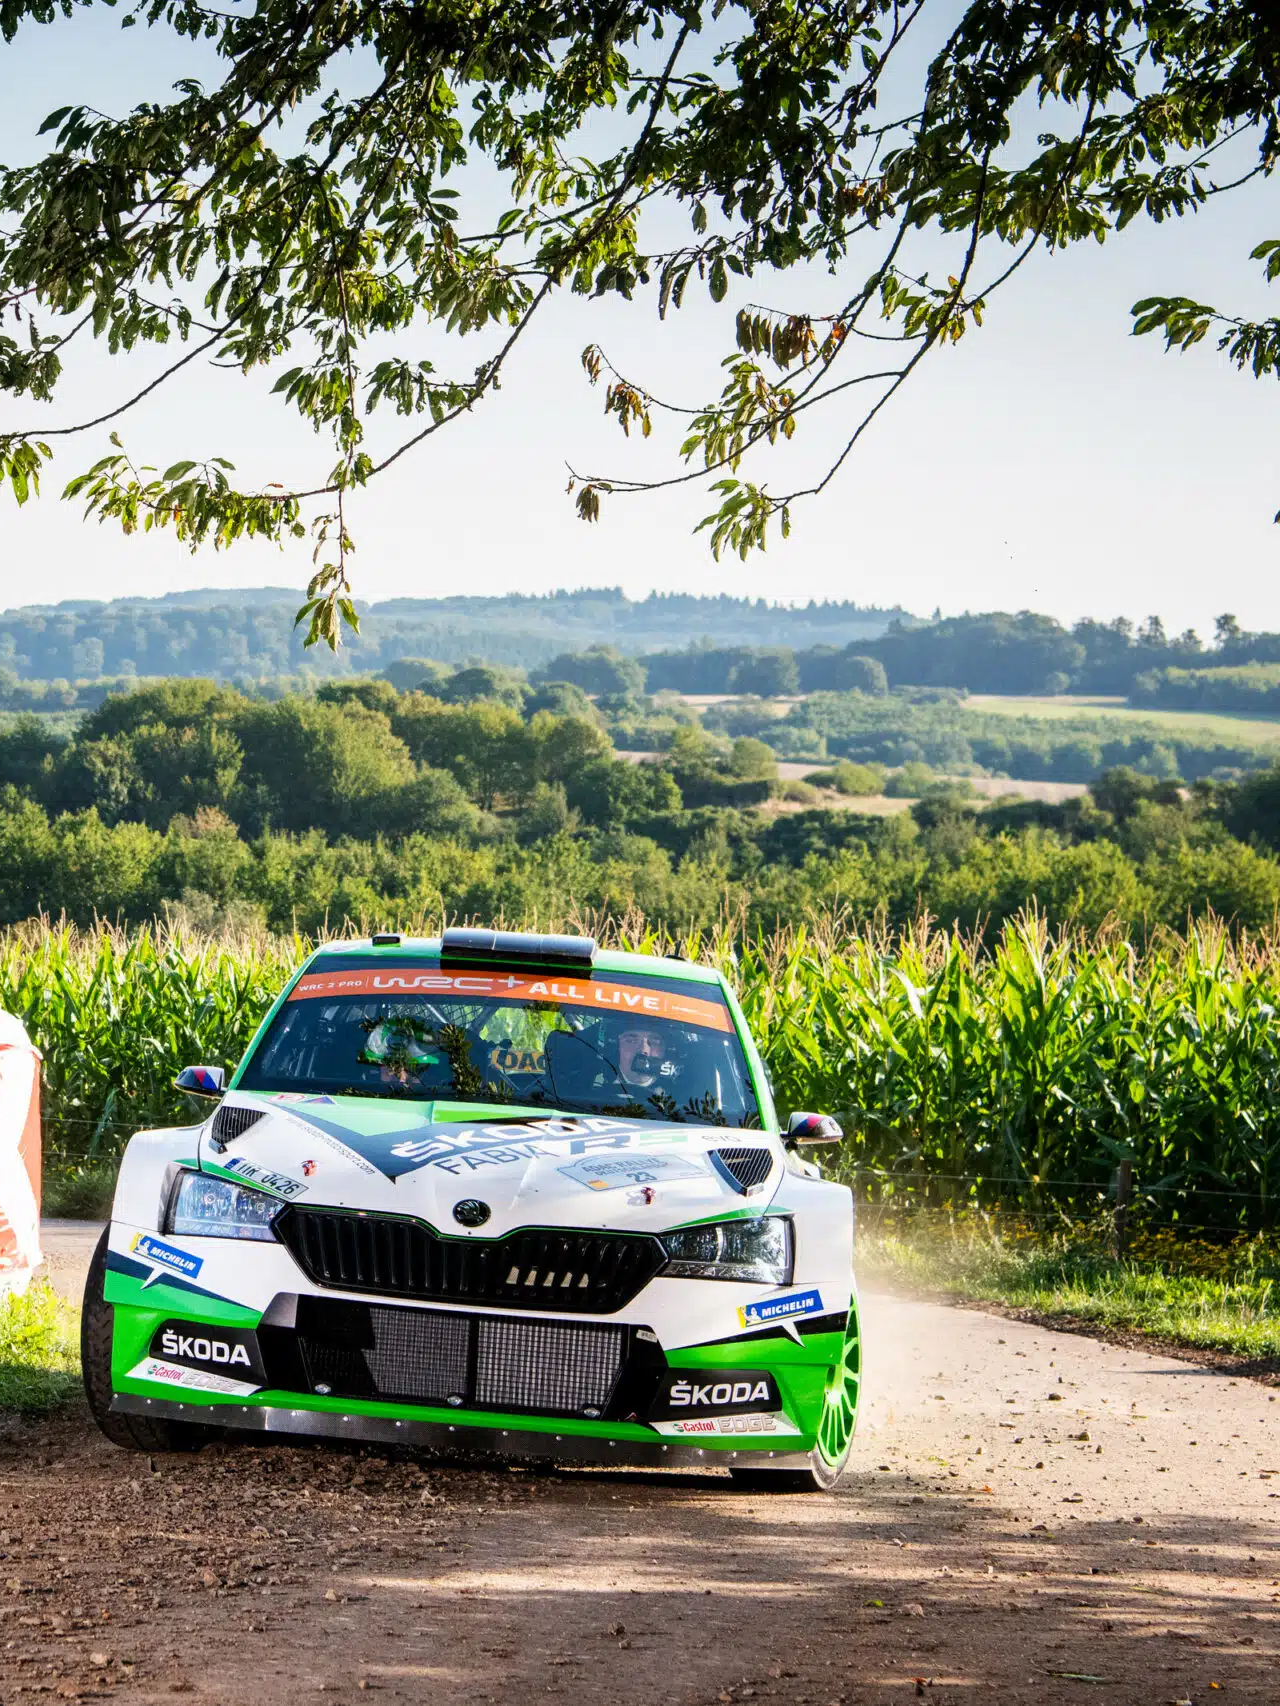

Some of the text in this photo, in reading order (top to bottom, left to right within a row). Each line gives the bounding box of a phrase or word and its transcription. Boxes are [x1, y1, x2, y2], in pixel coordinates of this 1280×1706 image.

[299, 983, 324, 992] WRC
[339, 980, 362, 988] PRO
[528, 981, 585, 1000] ALL
[595, 988, 661, 1011] LIVE
[389, 1117, 642, 1164] ŠKODA
[433, 1142, 560, 1175] FABIA
[626, 1171, 658, 1183] 23
[150, 1246, 196, 1271] MICHELIN
[761, 1297, 814, 1318] MICHELIN
[162, 1328, 251, 1367] ŠKODA
[155, 1366, 185, 1381] Castrol
[669, 1379, 770, 1406] ŠKODA
[683, 1414, 777, 1433] Castrol EDGE
